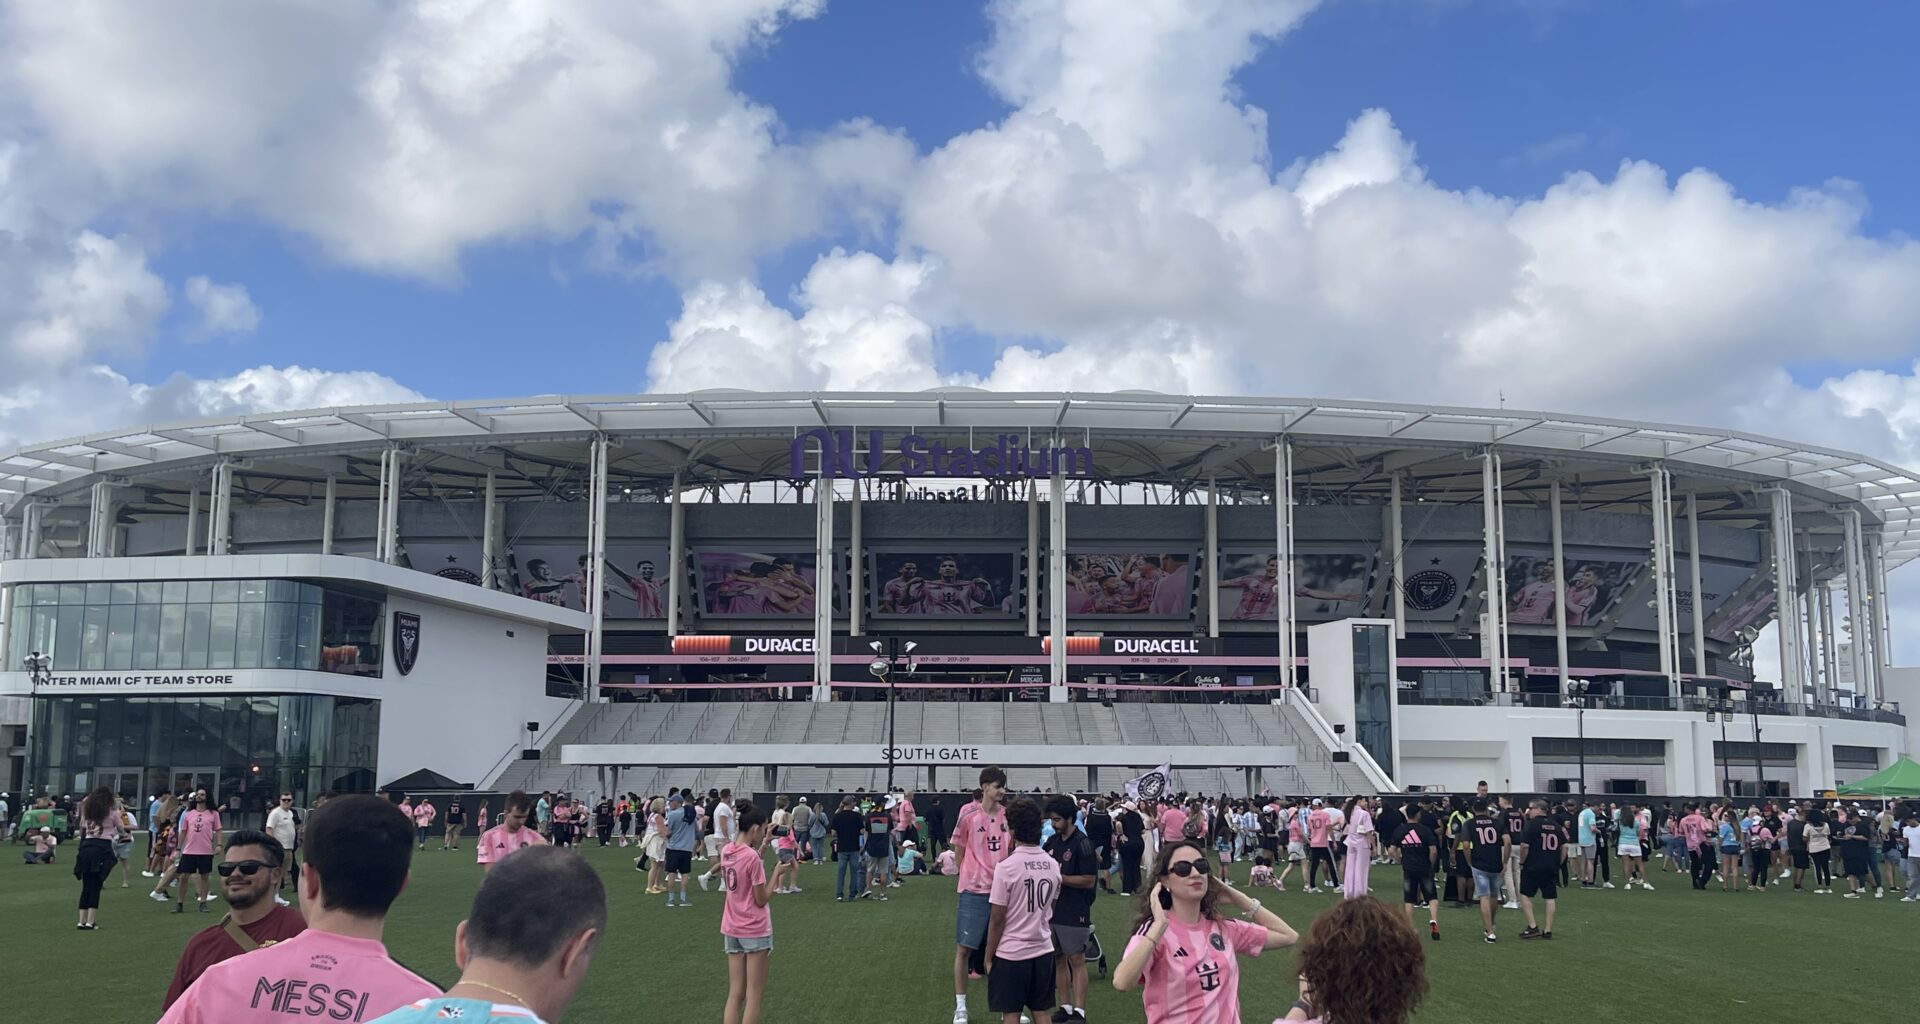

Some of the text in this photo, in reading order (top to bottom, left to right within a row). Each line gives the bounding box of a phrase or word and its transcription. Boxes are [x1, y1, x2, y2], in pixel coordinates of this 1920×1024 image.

[900, 434, 1093, 476] Stadium
[1114, 639, 1199, 653] DURACELL
[80, 676, 121, 686] MIAMI
[124, 676, 141, 686] CF
[146, 676, 183, 685] TEAM
[186, 675, 233, 685] STORE
[881, 748, 979, 760] SOUTH GATE
[1508, 818, 1522, 832] 10
[1476, 827, 1497, 845] 10
[1541, 832, 1558, 851] 10
[1024, 861, 1051, 870] MESSI
[1024, 877, 1053, 913] 10
[250, 976, 370, 1023] MESSI
